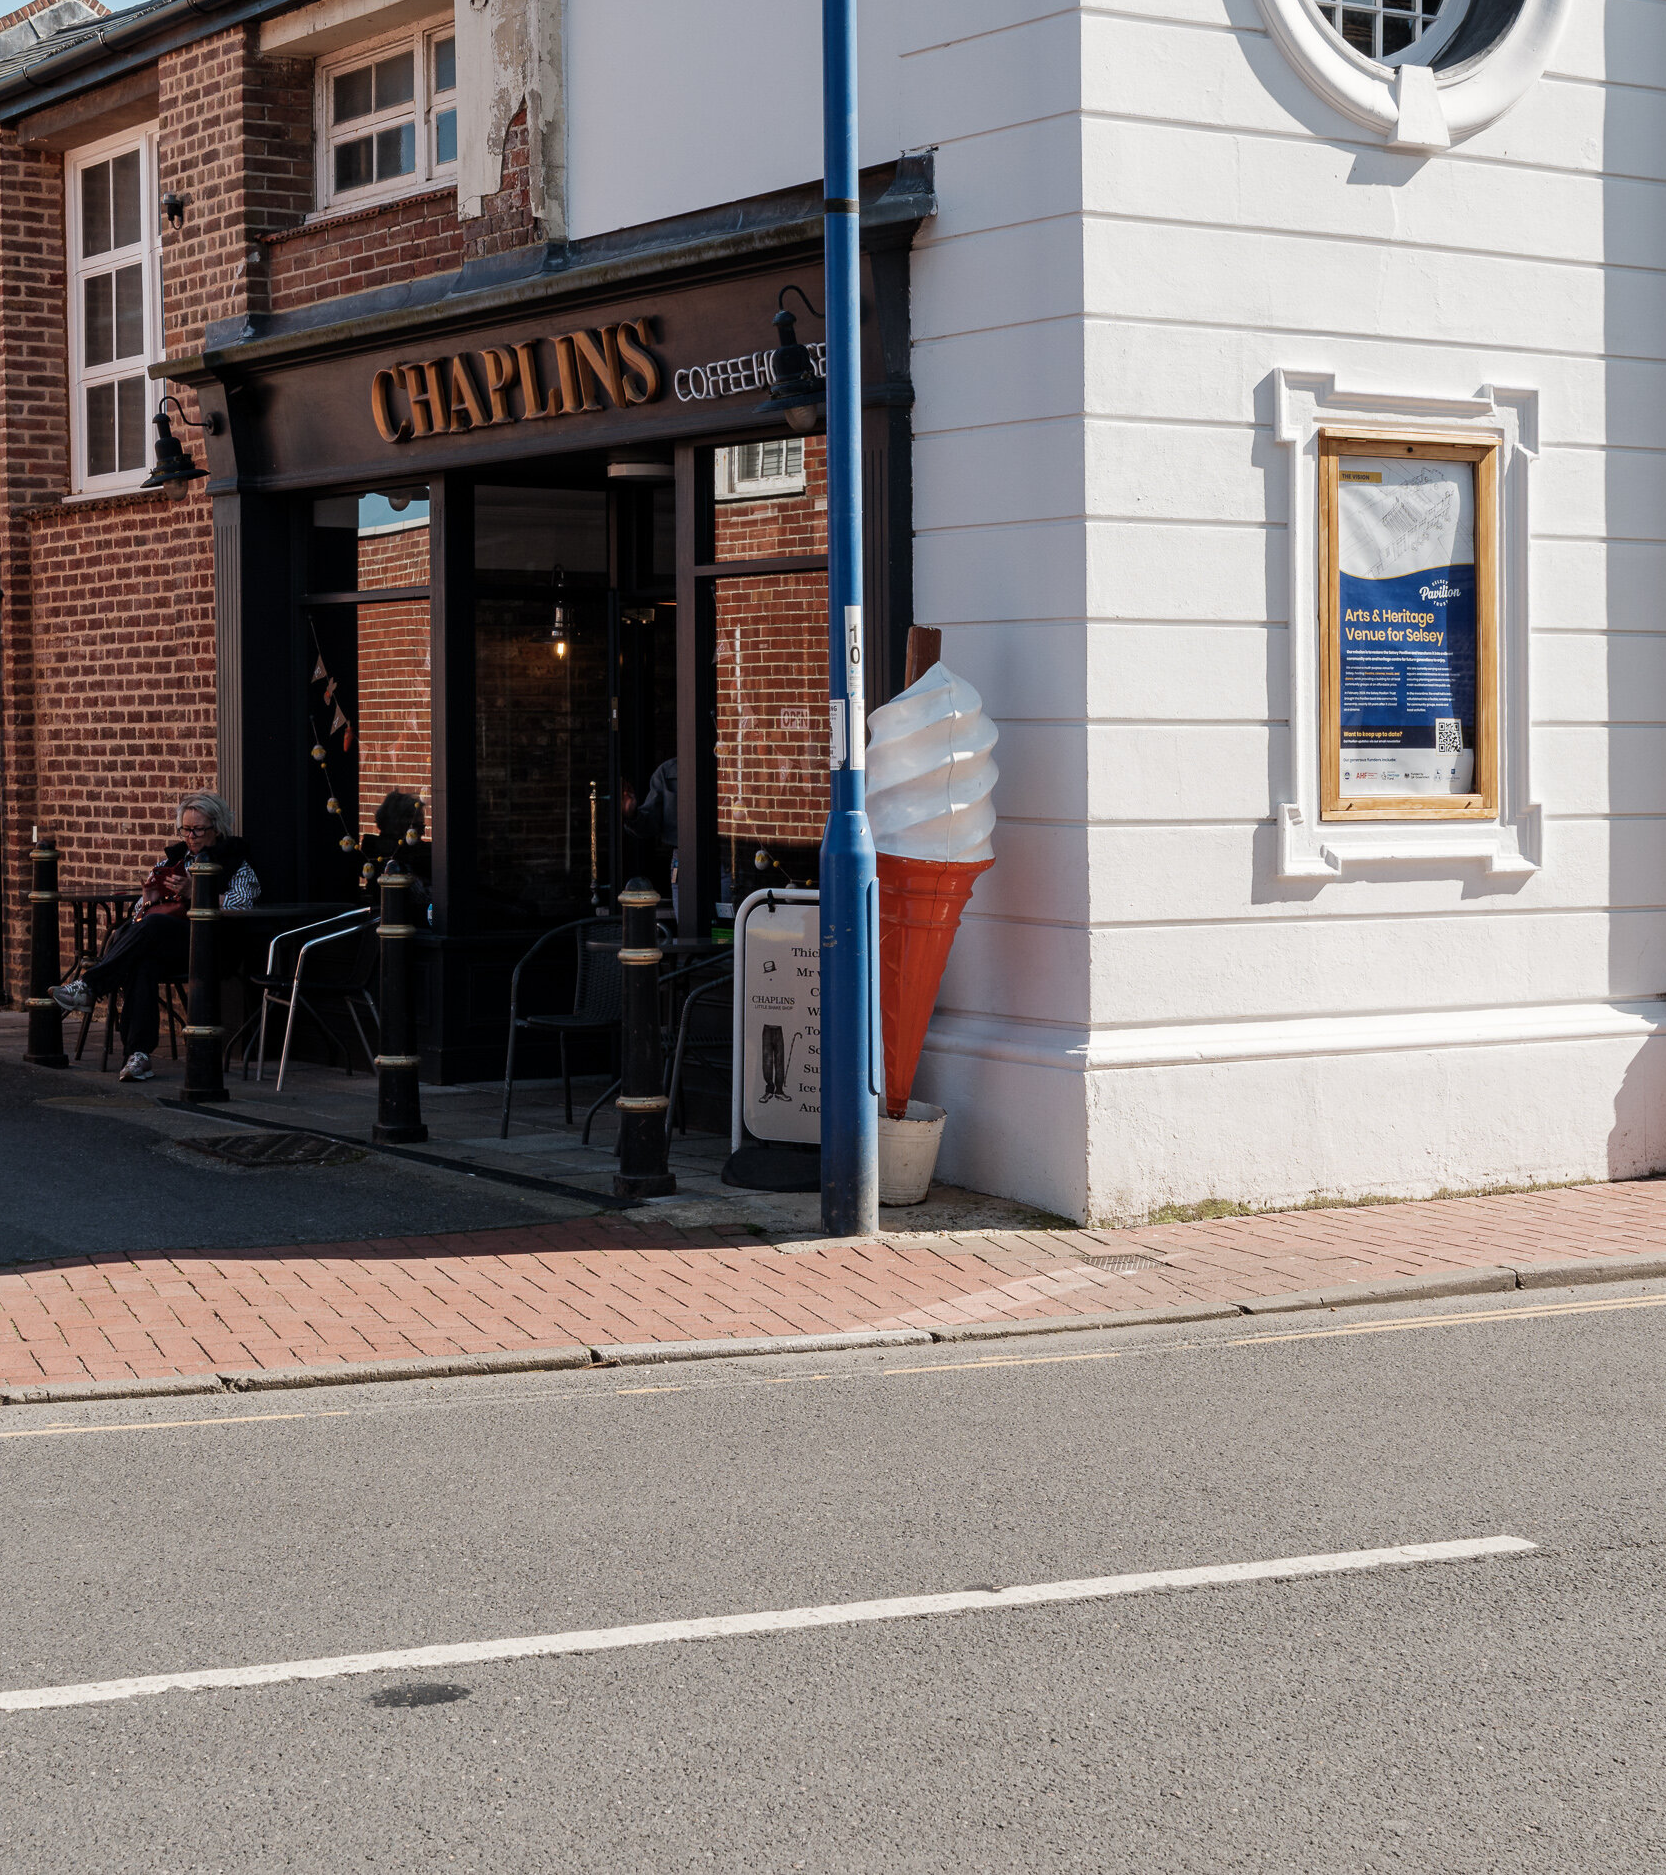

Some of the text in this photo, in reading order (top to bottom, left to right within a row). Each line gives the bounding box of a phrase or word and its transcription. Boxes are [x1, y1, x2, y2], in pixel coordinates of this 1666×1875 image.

[371, 316, 661, 444] CHAPLINS
[1419, 584, 1461, 601] Pavilion
[1345, 609, 1434, 627] Arts & Heritage
[1346, 628, 1444, 647] Venue for Selsey
[783, 710, 808, 727] OPEN
[796, 967, 814, 977] Mr
[752, 995, 795, 1005] CHAPLINS
[799, 1083, 816, 1093] Ice
